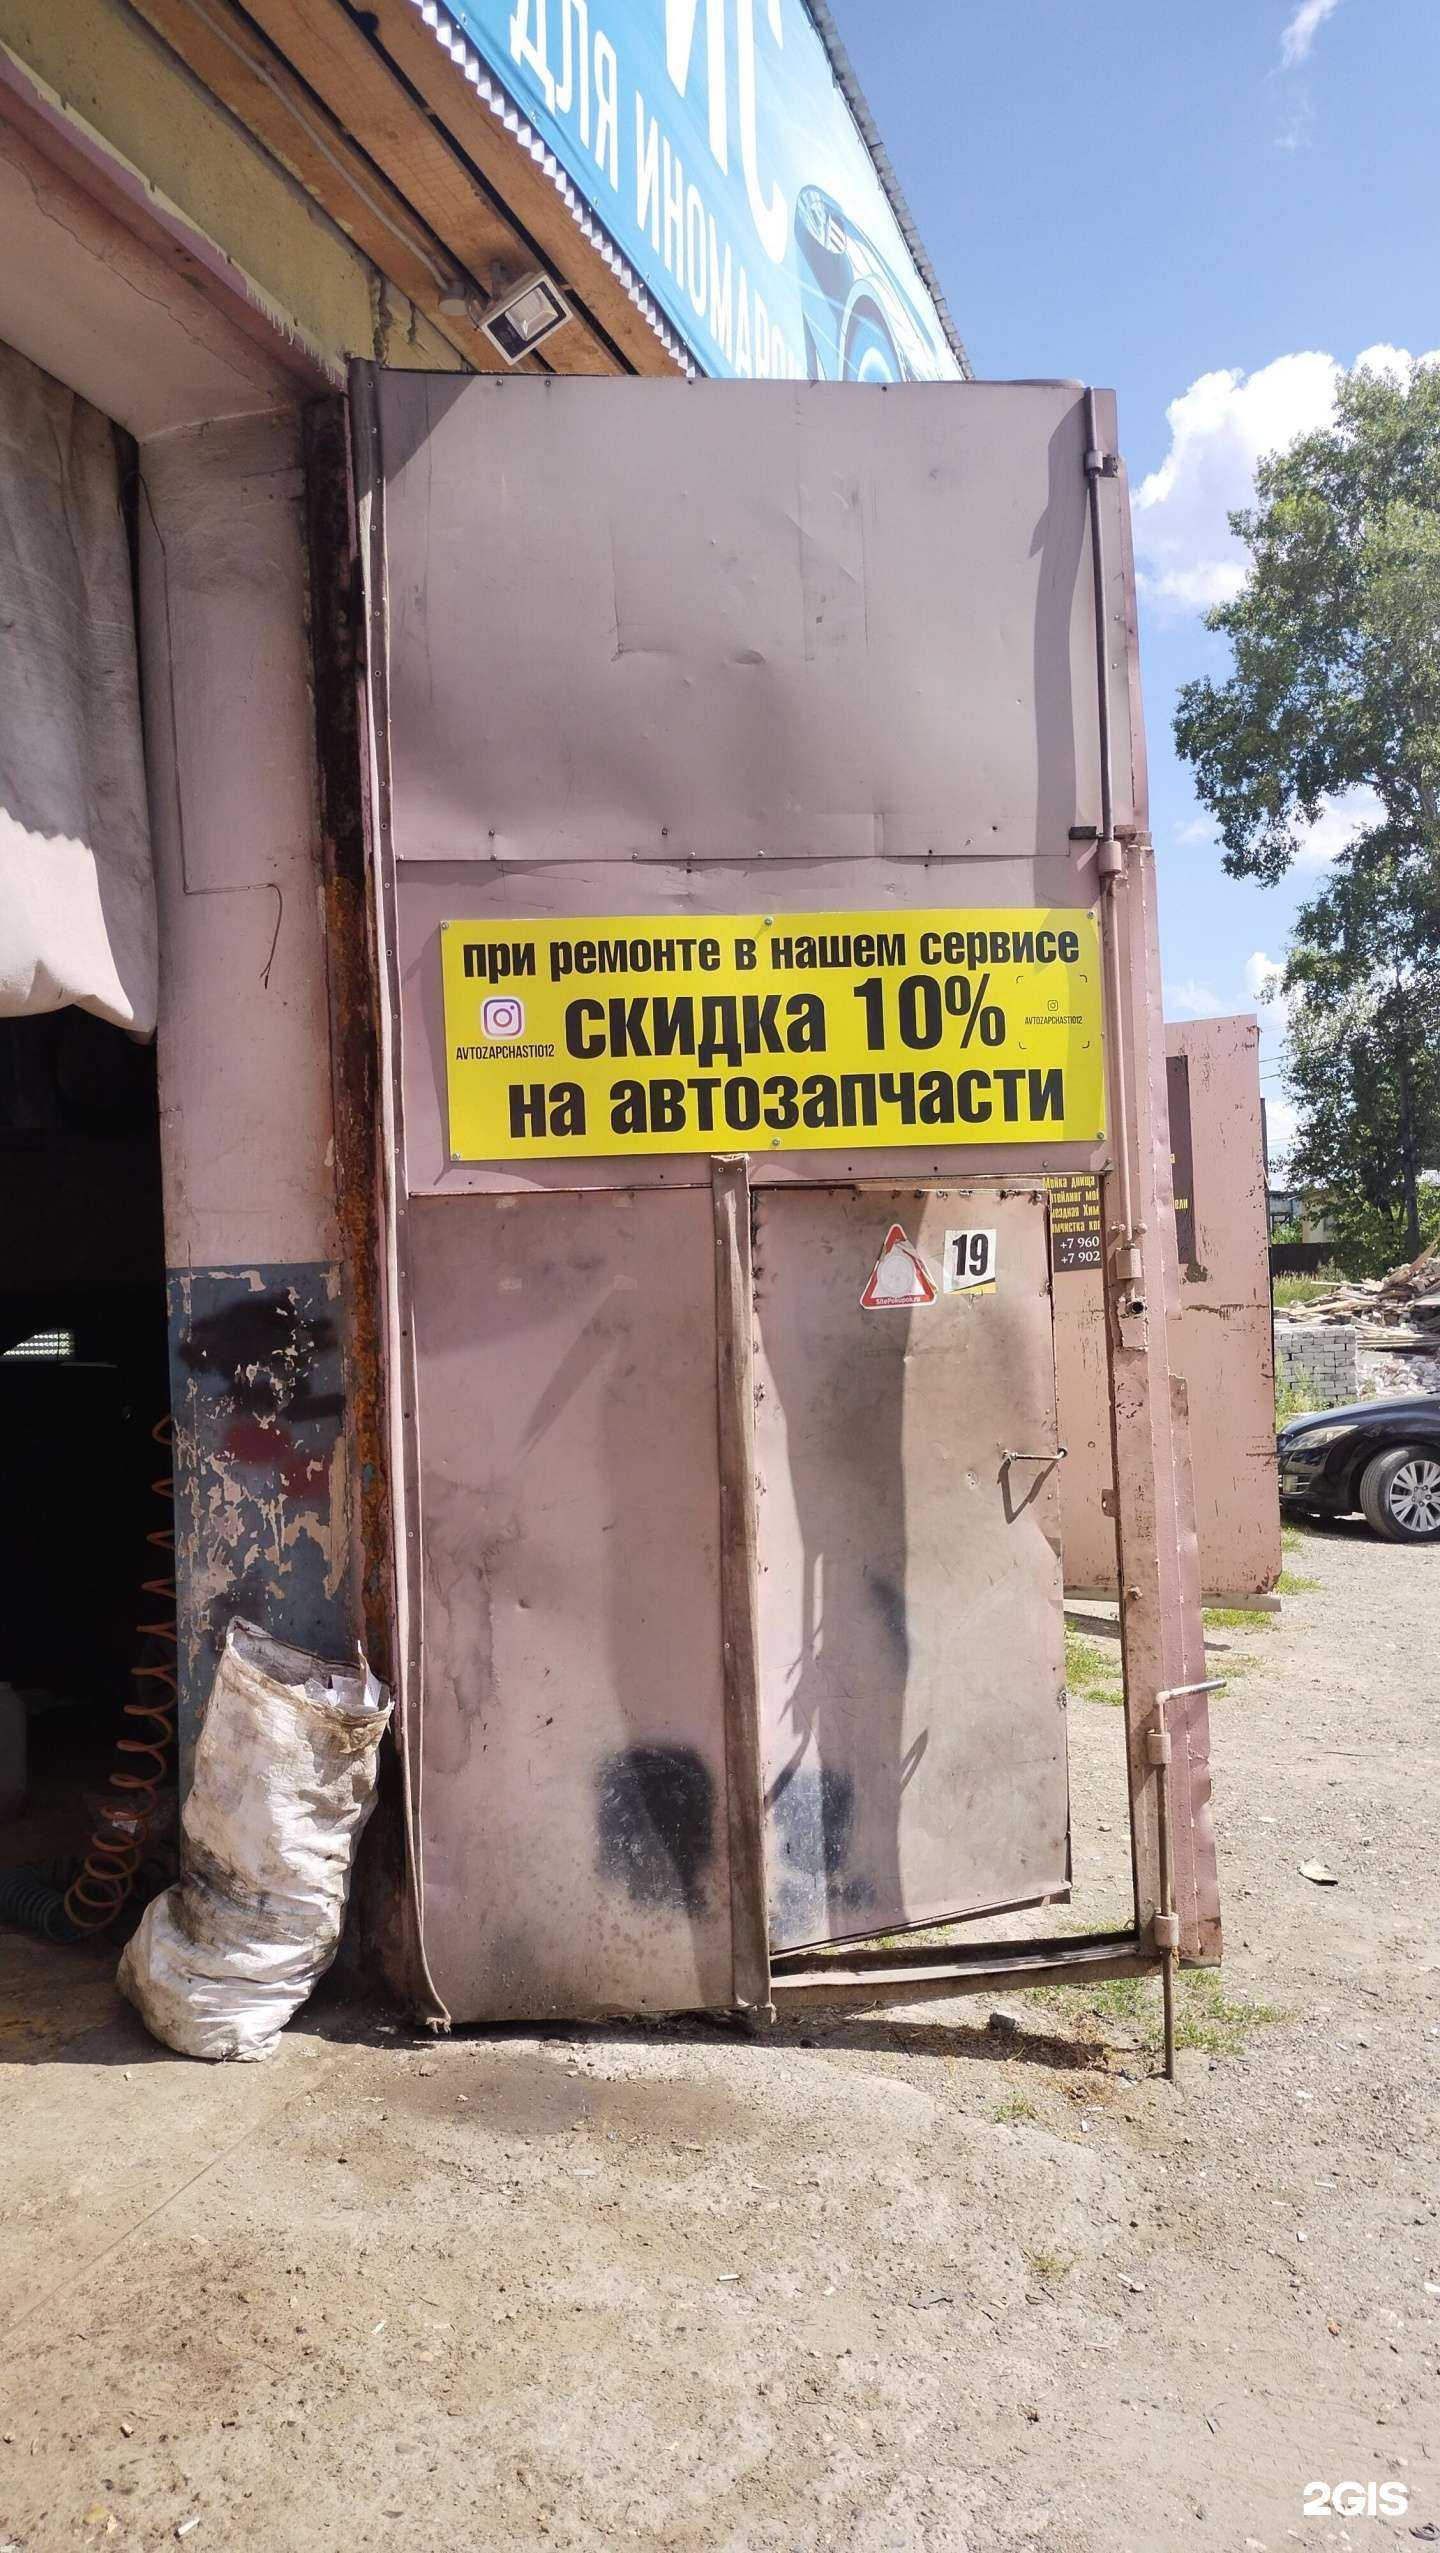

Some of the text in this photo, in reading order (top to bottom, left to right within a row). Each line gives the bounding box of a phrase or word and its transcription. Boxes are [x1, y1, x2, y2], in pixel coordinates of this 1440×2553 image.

[635, 89, 804, 378] ИНОМАР
[463, 930, 1080, 984] при ремонте в нашем сервисе
[853, 973, 1006, 1051] 10%
[456, 1044, 555, 1060] AVTOZAPCHASTI012
[508, 1068, 1065, 1138] на автозапчасти
[952, 1233, 989, 1276] 19
[1060, 1235, 1100, 1249] +7 960
[1061, 1250, 1101, 1264] +7 902
